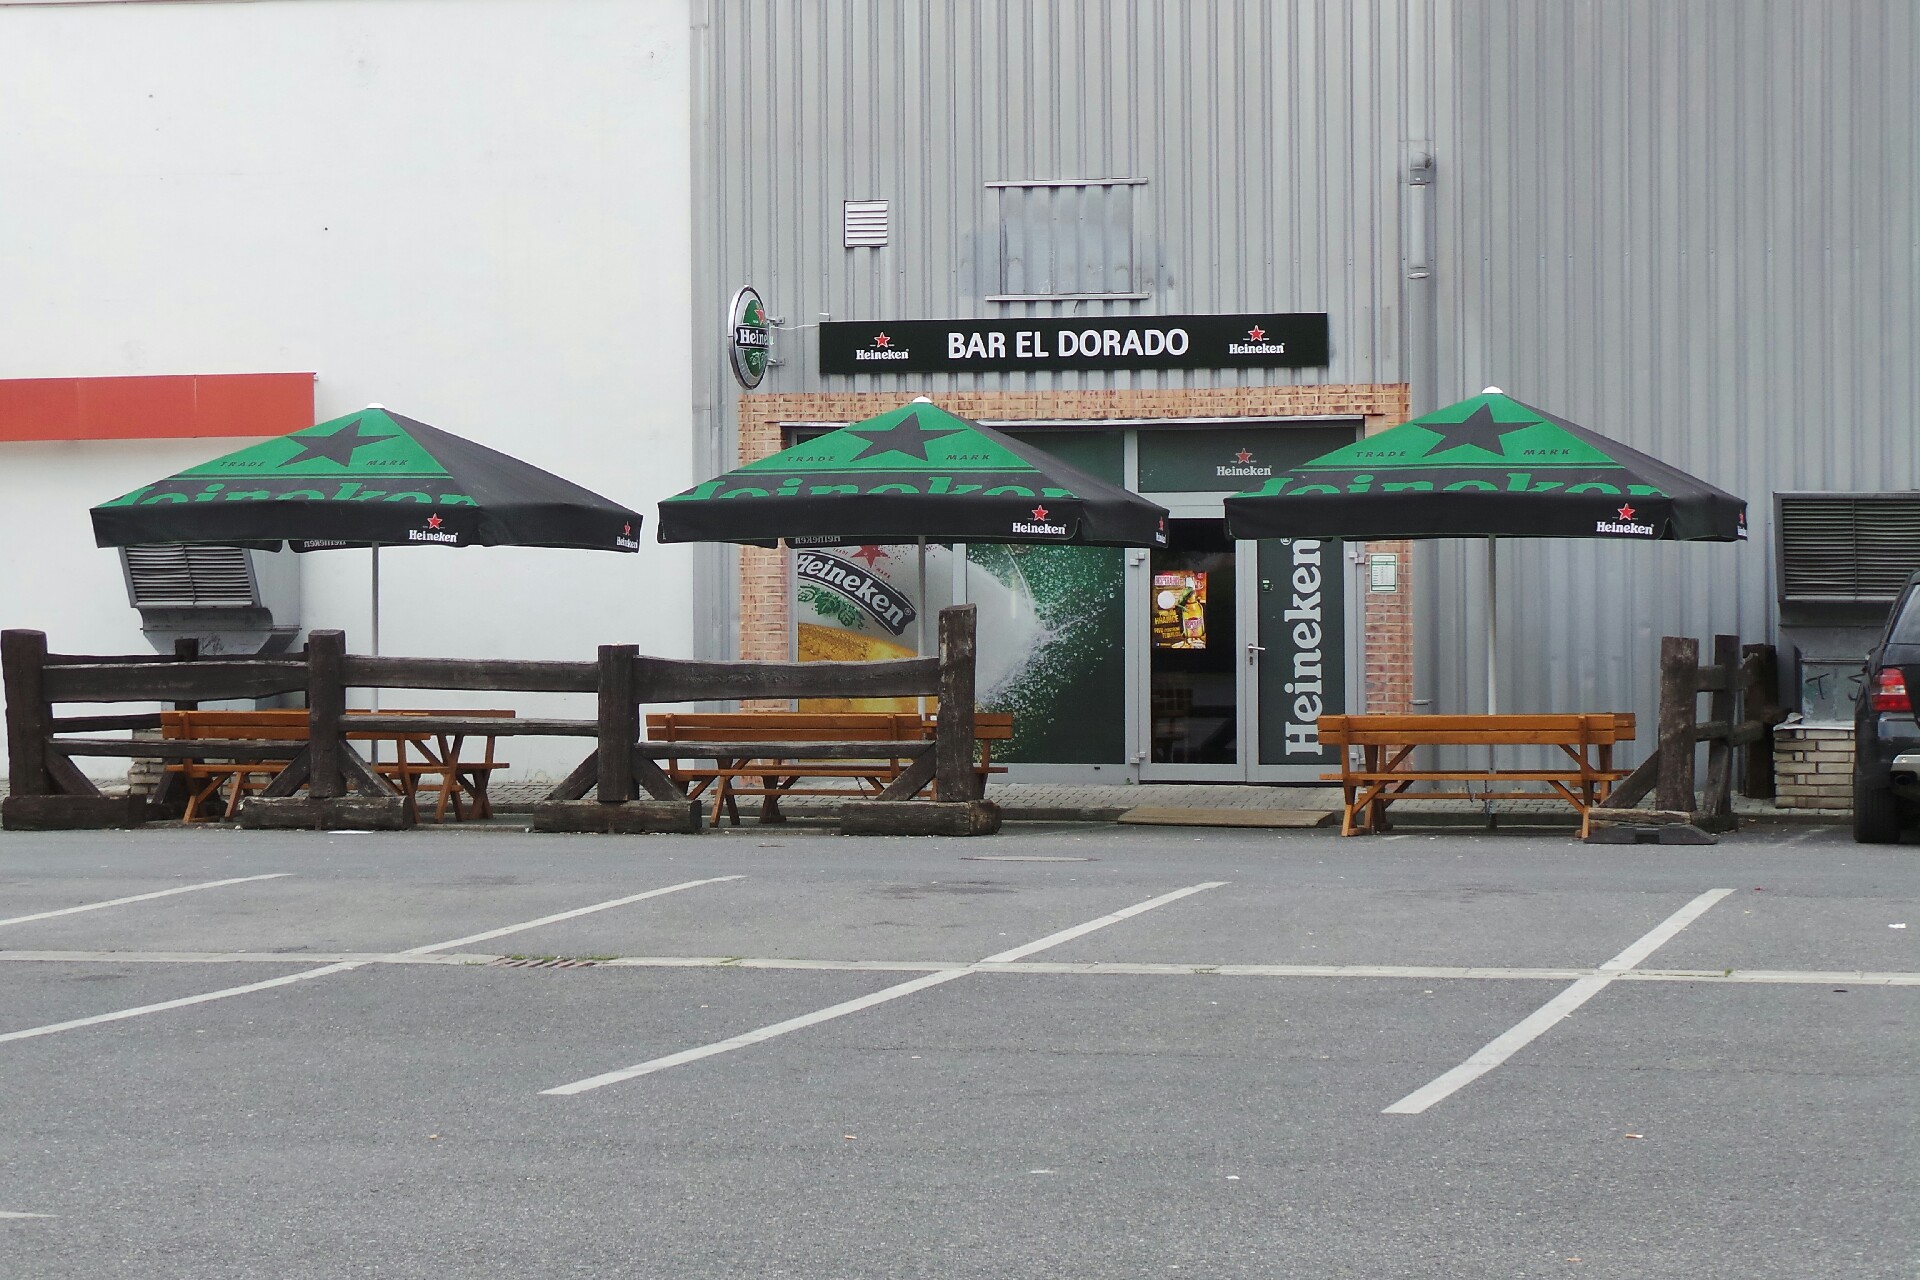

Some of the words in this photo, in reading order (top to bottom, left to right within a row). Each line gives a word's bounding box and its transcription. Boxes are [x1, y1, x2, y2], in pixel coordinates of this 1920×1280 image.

[947, 332, 1006, 359] BAR
[1015, 331, 1049, 358] EL
[1058, 328, 1190, 357] DORADO
[1228, 342, 1285, 355] Heineken
[855, 349, 909, 360] Heineken
[945, 453, 991, 461] MARK
[1355, 450, 1407, 458] TRADE
[1523, 448, 1571, 456] MARK
[366, 459, 410, 467] MARK
[1216, 465, 1272, 476] Heineken
[1011, 522, 1066, 535] Heineken
[1595, 521, 1654, 535] Heineken
[408, 529, 457, 543] Heineken
[798, 555, 904, 627] Heineken
[1284, 539, 1323, 756] Heineken
